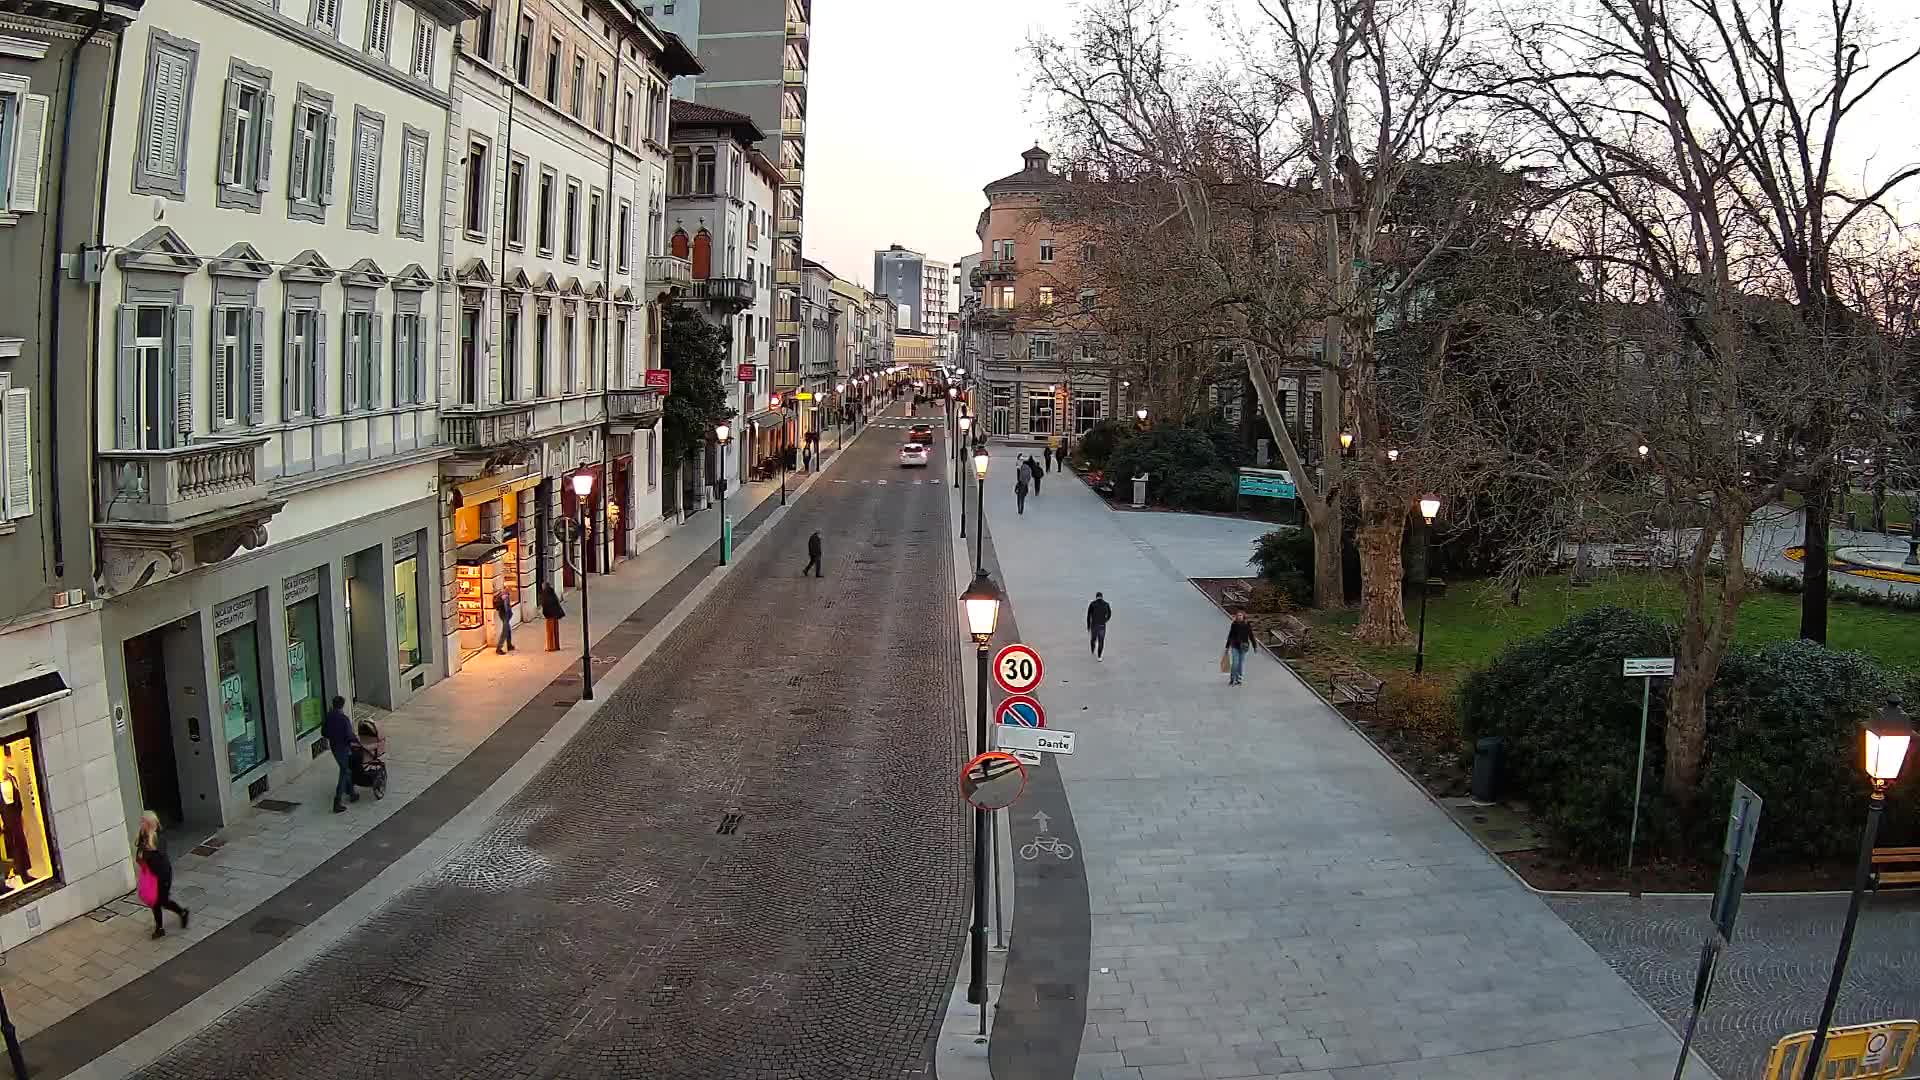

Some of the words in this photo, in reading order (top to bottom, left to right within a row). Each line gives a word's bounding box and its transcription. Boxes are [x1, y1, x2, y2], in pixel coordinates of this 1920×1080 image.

[1005, 658, 1033, 681] 30
[222, 677, 240, 700] 130
[1038, 738, 1070, 750] Dante
